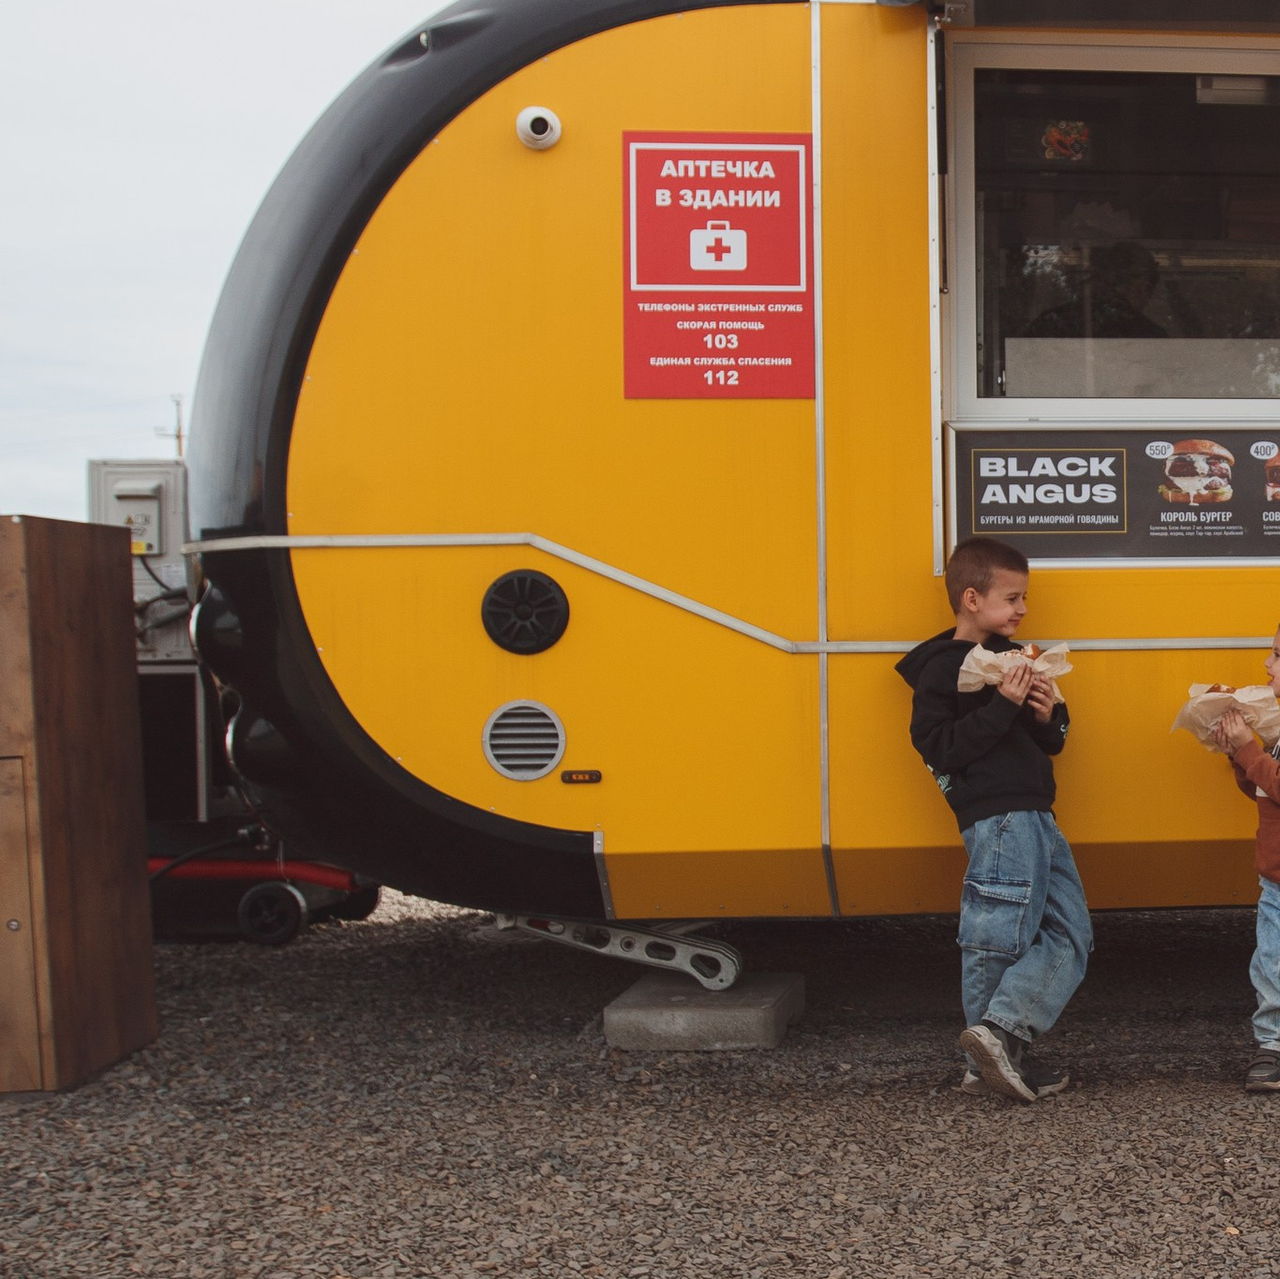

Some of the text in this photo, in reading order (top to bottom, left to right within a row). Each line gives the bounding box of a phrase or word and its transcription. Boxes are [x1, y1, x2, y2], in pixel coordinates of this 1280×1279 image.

[661, 160, 775, 177] АПТЕЧКА
[656, 189, 780, 209] В ЗДАНИИ
[638, 303, 802, 312] ТЕЛЕФОНЫ ЭКСТРЕННЫХ СЛУЖБ
[677, 321, 764, 330] СКОРАЯ ПОМОЩЬ
[704, 334, 738, 348] 103
[650, 357, 690, 366] ЕДИНАЯ
[704, 371, 739, 384] 112
[980, 457, 1116, 476] BLACK
[981, 484, 1117, 503] ANGUS
[981, 514, 1118, 525] БУРГЕРЫ ИЗ МРАМОРНОЙ ГОВЯДИНЫ
[1161, 512, 1232, 523] КОРОЛЬ БУРГЕР
